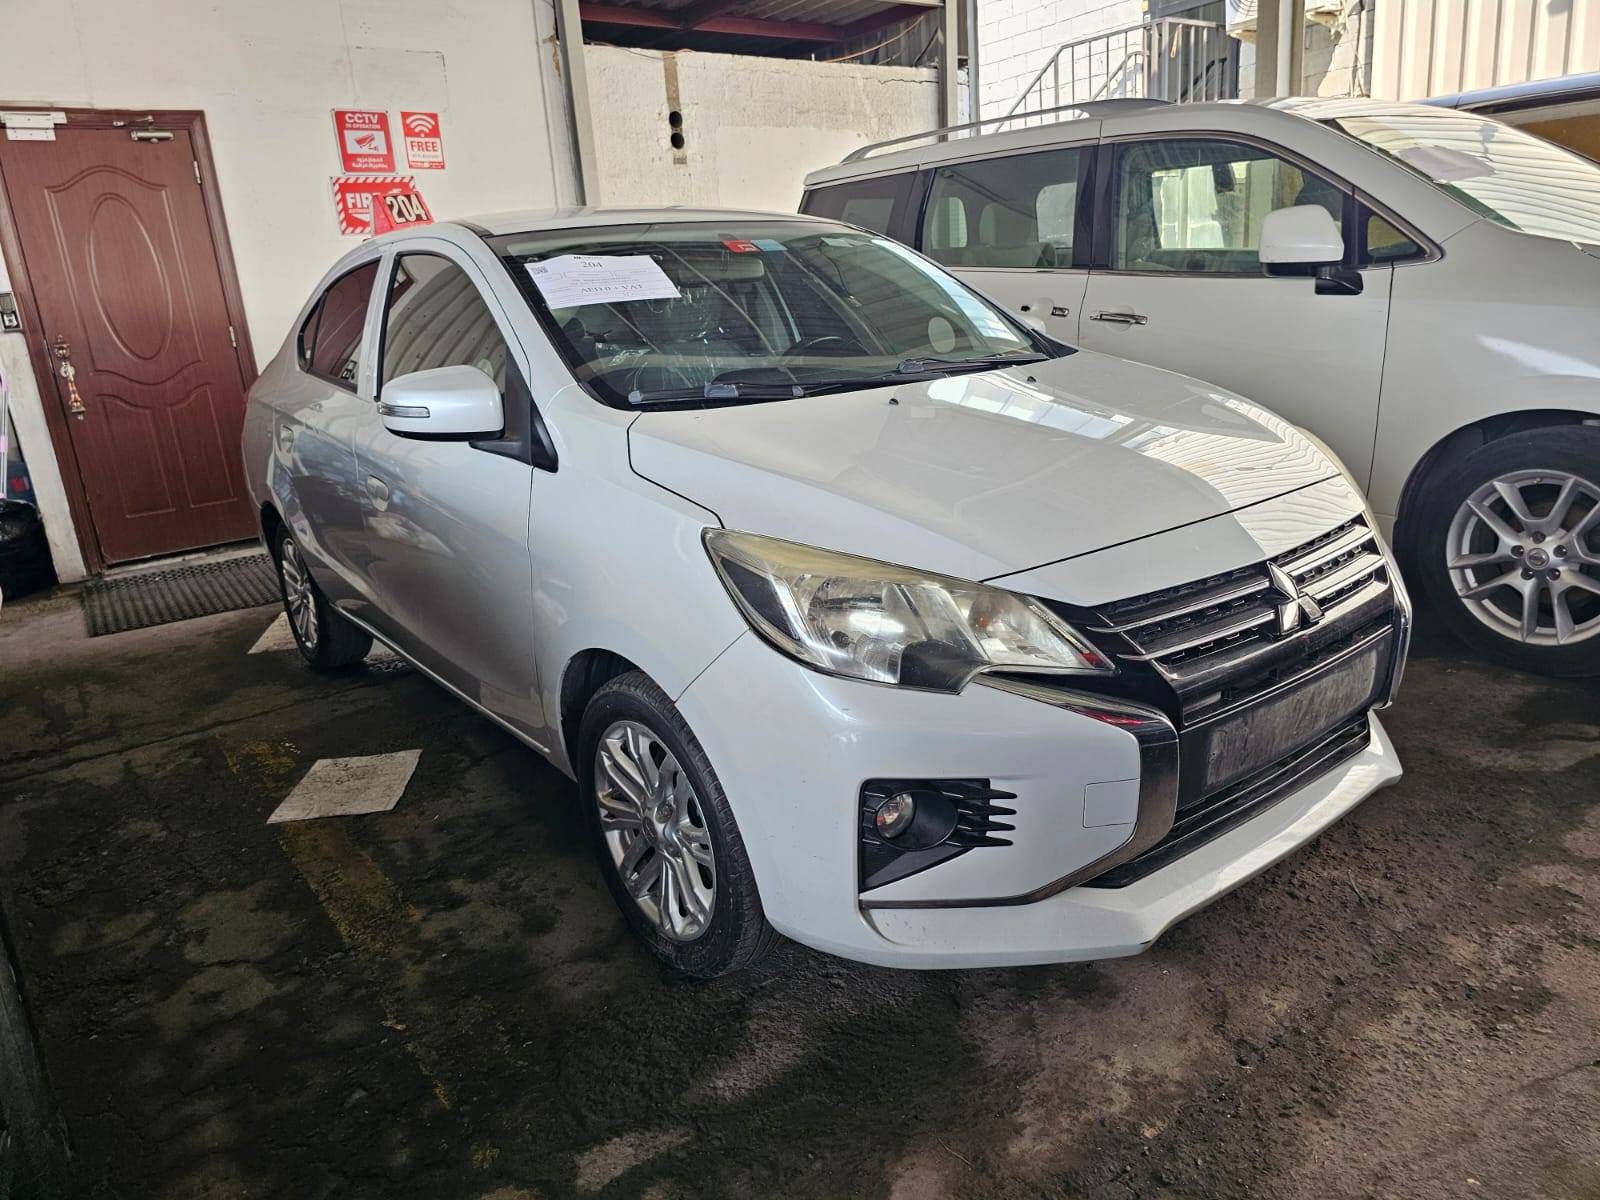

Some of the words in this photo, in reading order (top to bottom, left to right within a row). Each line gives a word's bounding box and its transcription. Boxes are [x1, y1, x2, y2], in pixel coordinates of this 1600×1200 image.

[345, 113, 378, 124] CCTV
[410, 141, 438, 152] FREE
[346, 192, 373, 209] FIR
[385, 194, 428, 223] 204
[581, 261, 603, 269] 204
